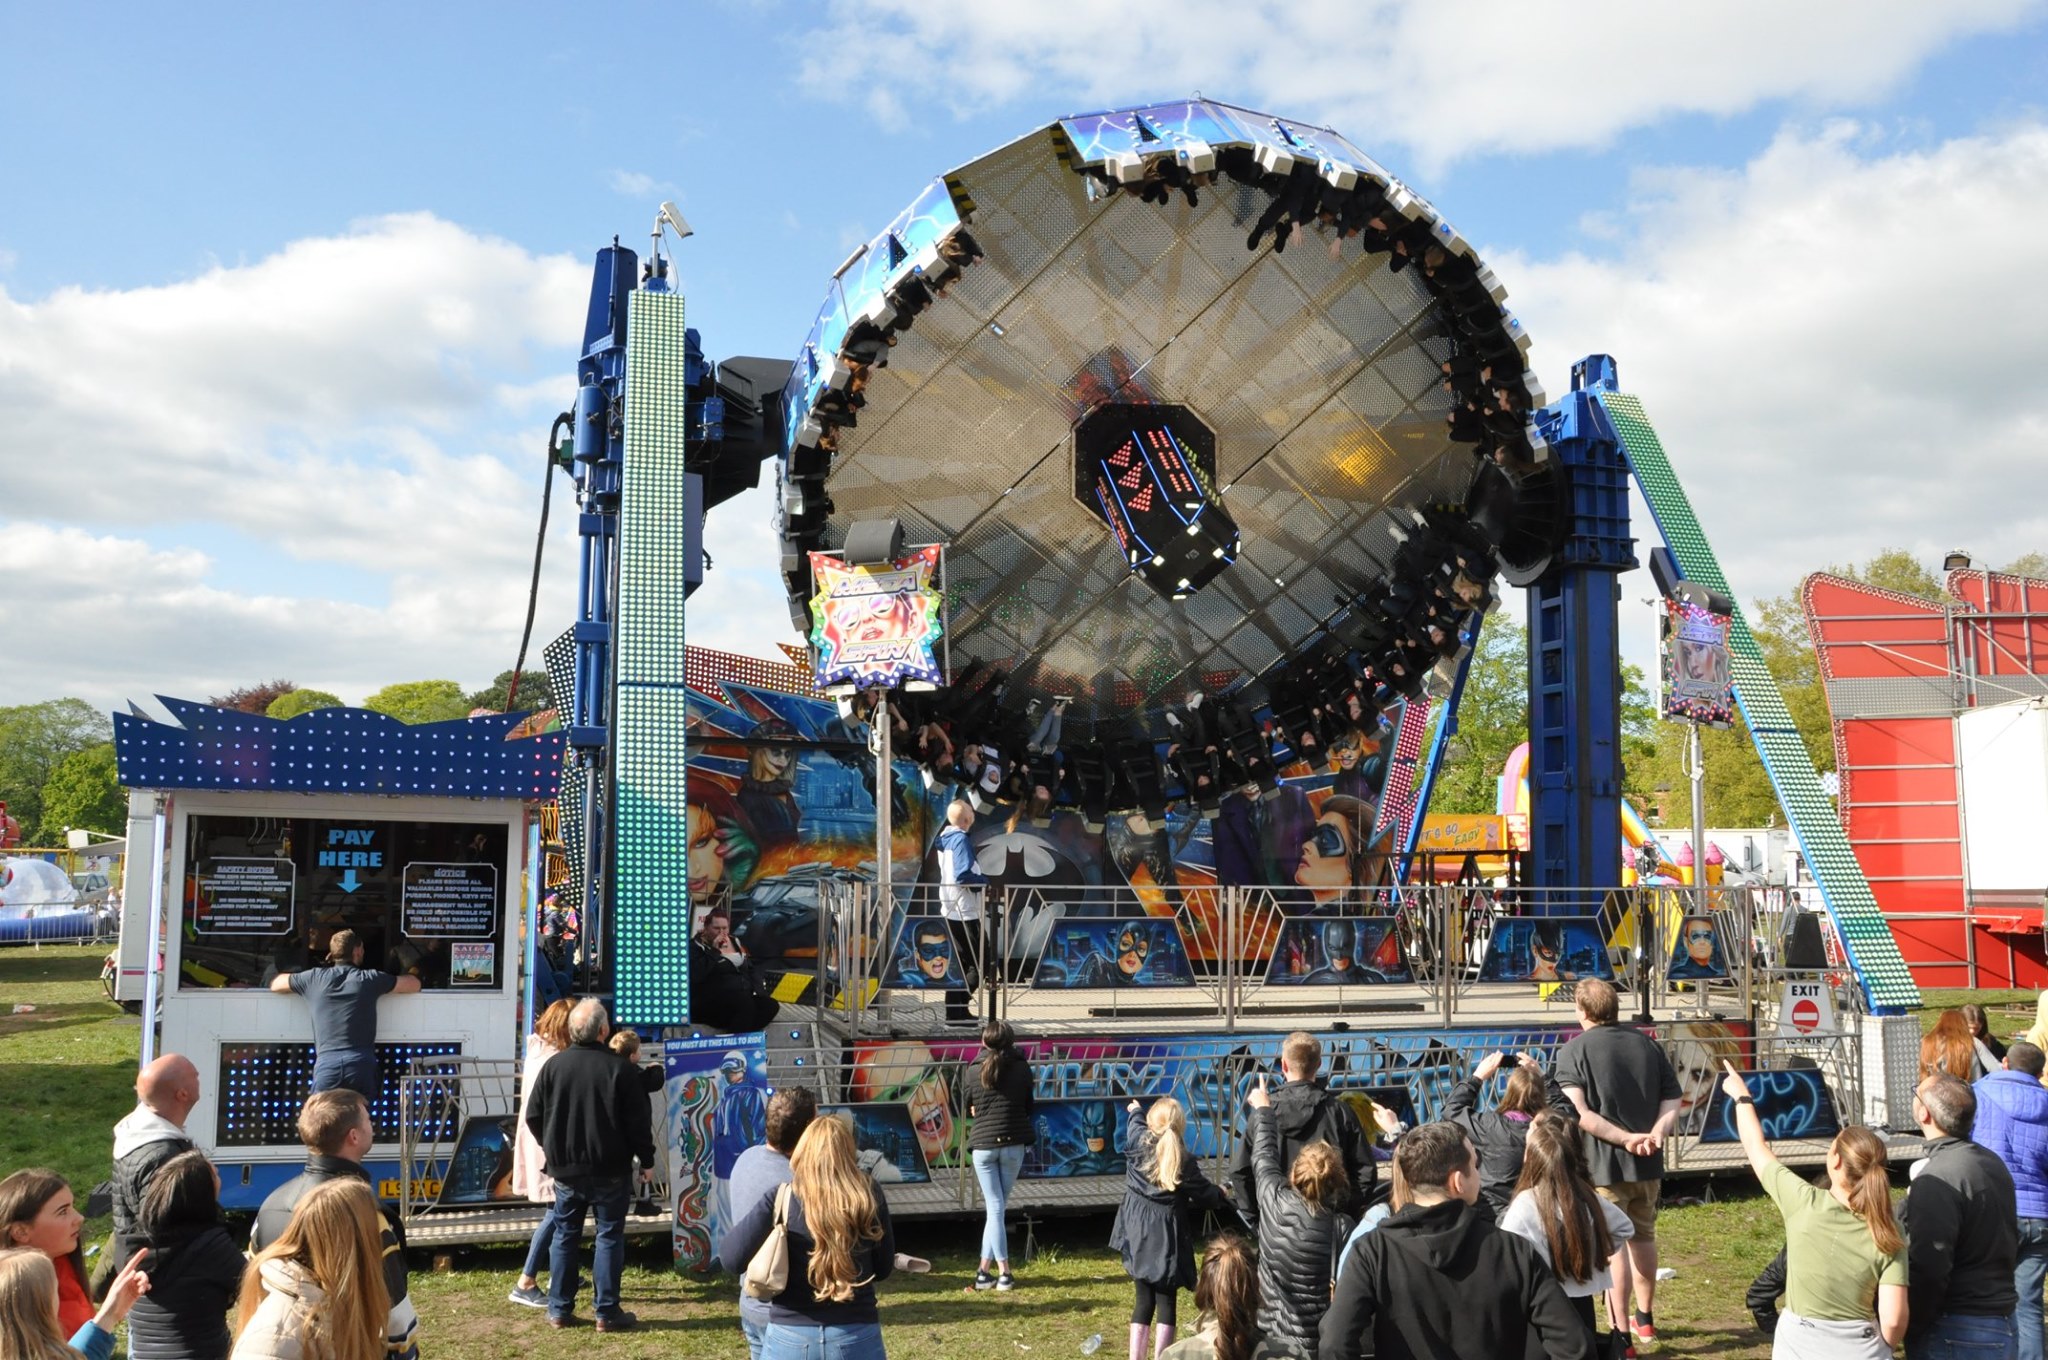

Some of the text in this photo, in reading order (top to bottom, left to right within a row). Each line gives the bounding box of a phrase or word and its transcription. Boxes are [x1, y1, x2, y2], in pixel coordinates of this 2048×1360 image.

[329, 829, 375, 845] PAY
[319, 851, 382, 867] HERE
[434, 869, 466, 878] NOTICE
[1792, 985, 1820, 996] EXIT
[667, 1036, 762, 1050] YOU MUST BE THIS TALL TO RIDE
